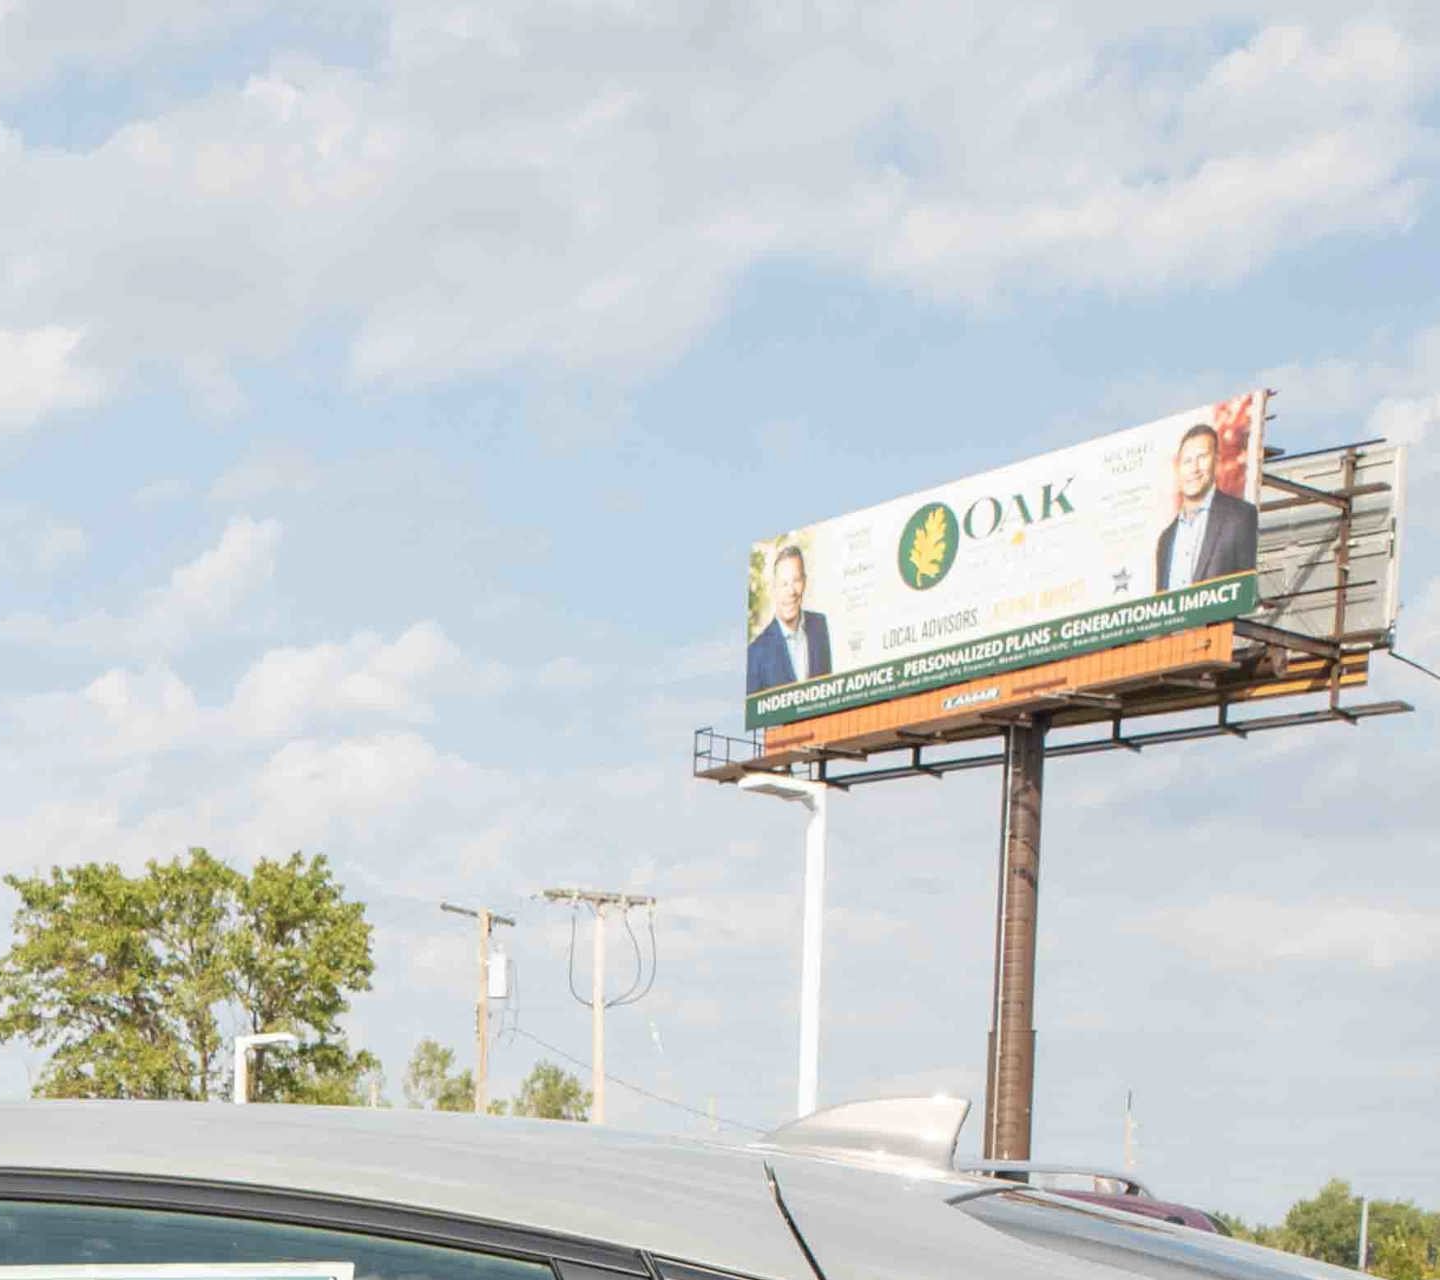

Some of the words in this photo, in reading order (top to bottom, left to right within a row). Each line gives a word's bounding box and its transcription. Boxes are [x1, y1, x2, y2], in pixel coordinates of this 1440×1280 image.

[962, 473, 1077, 541] OAK
[757, 682, 845, 715] INDEPENDENT
[846, 666, 894, 693] ADVICE
[903, 641, 1003, 679] PERSONALIZED
[1006, 627, 1052, 652] PLANS
[1060, 598, 1176, 639] GENERATIONAL
[1179, 583, 1242, 613] IMPACT
[881, 623, 918, 650] LOCAL
